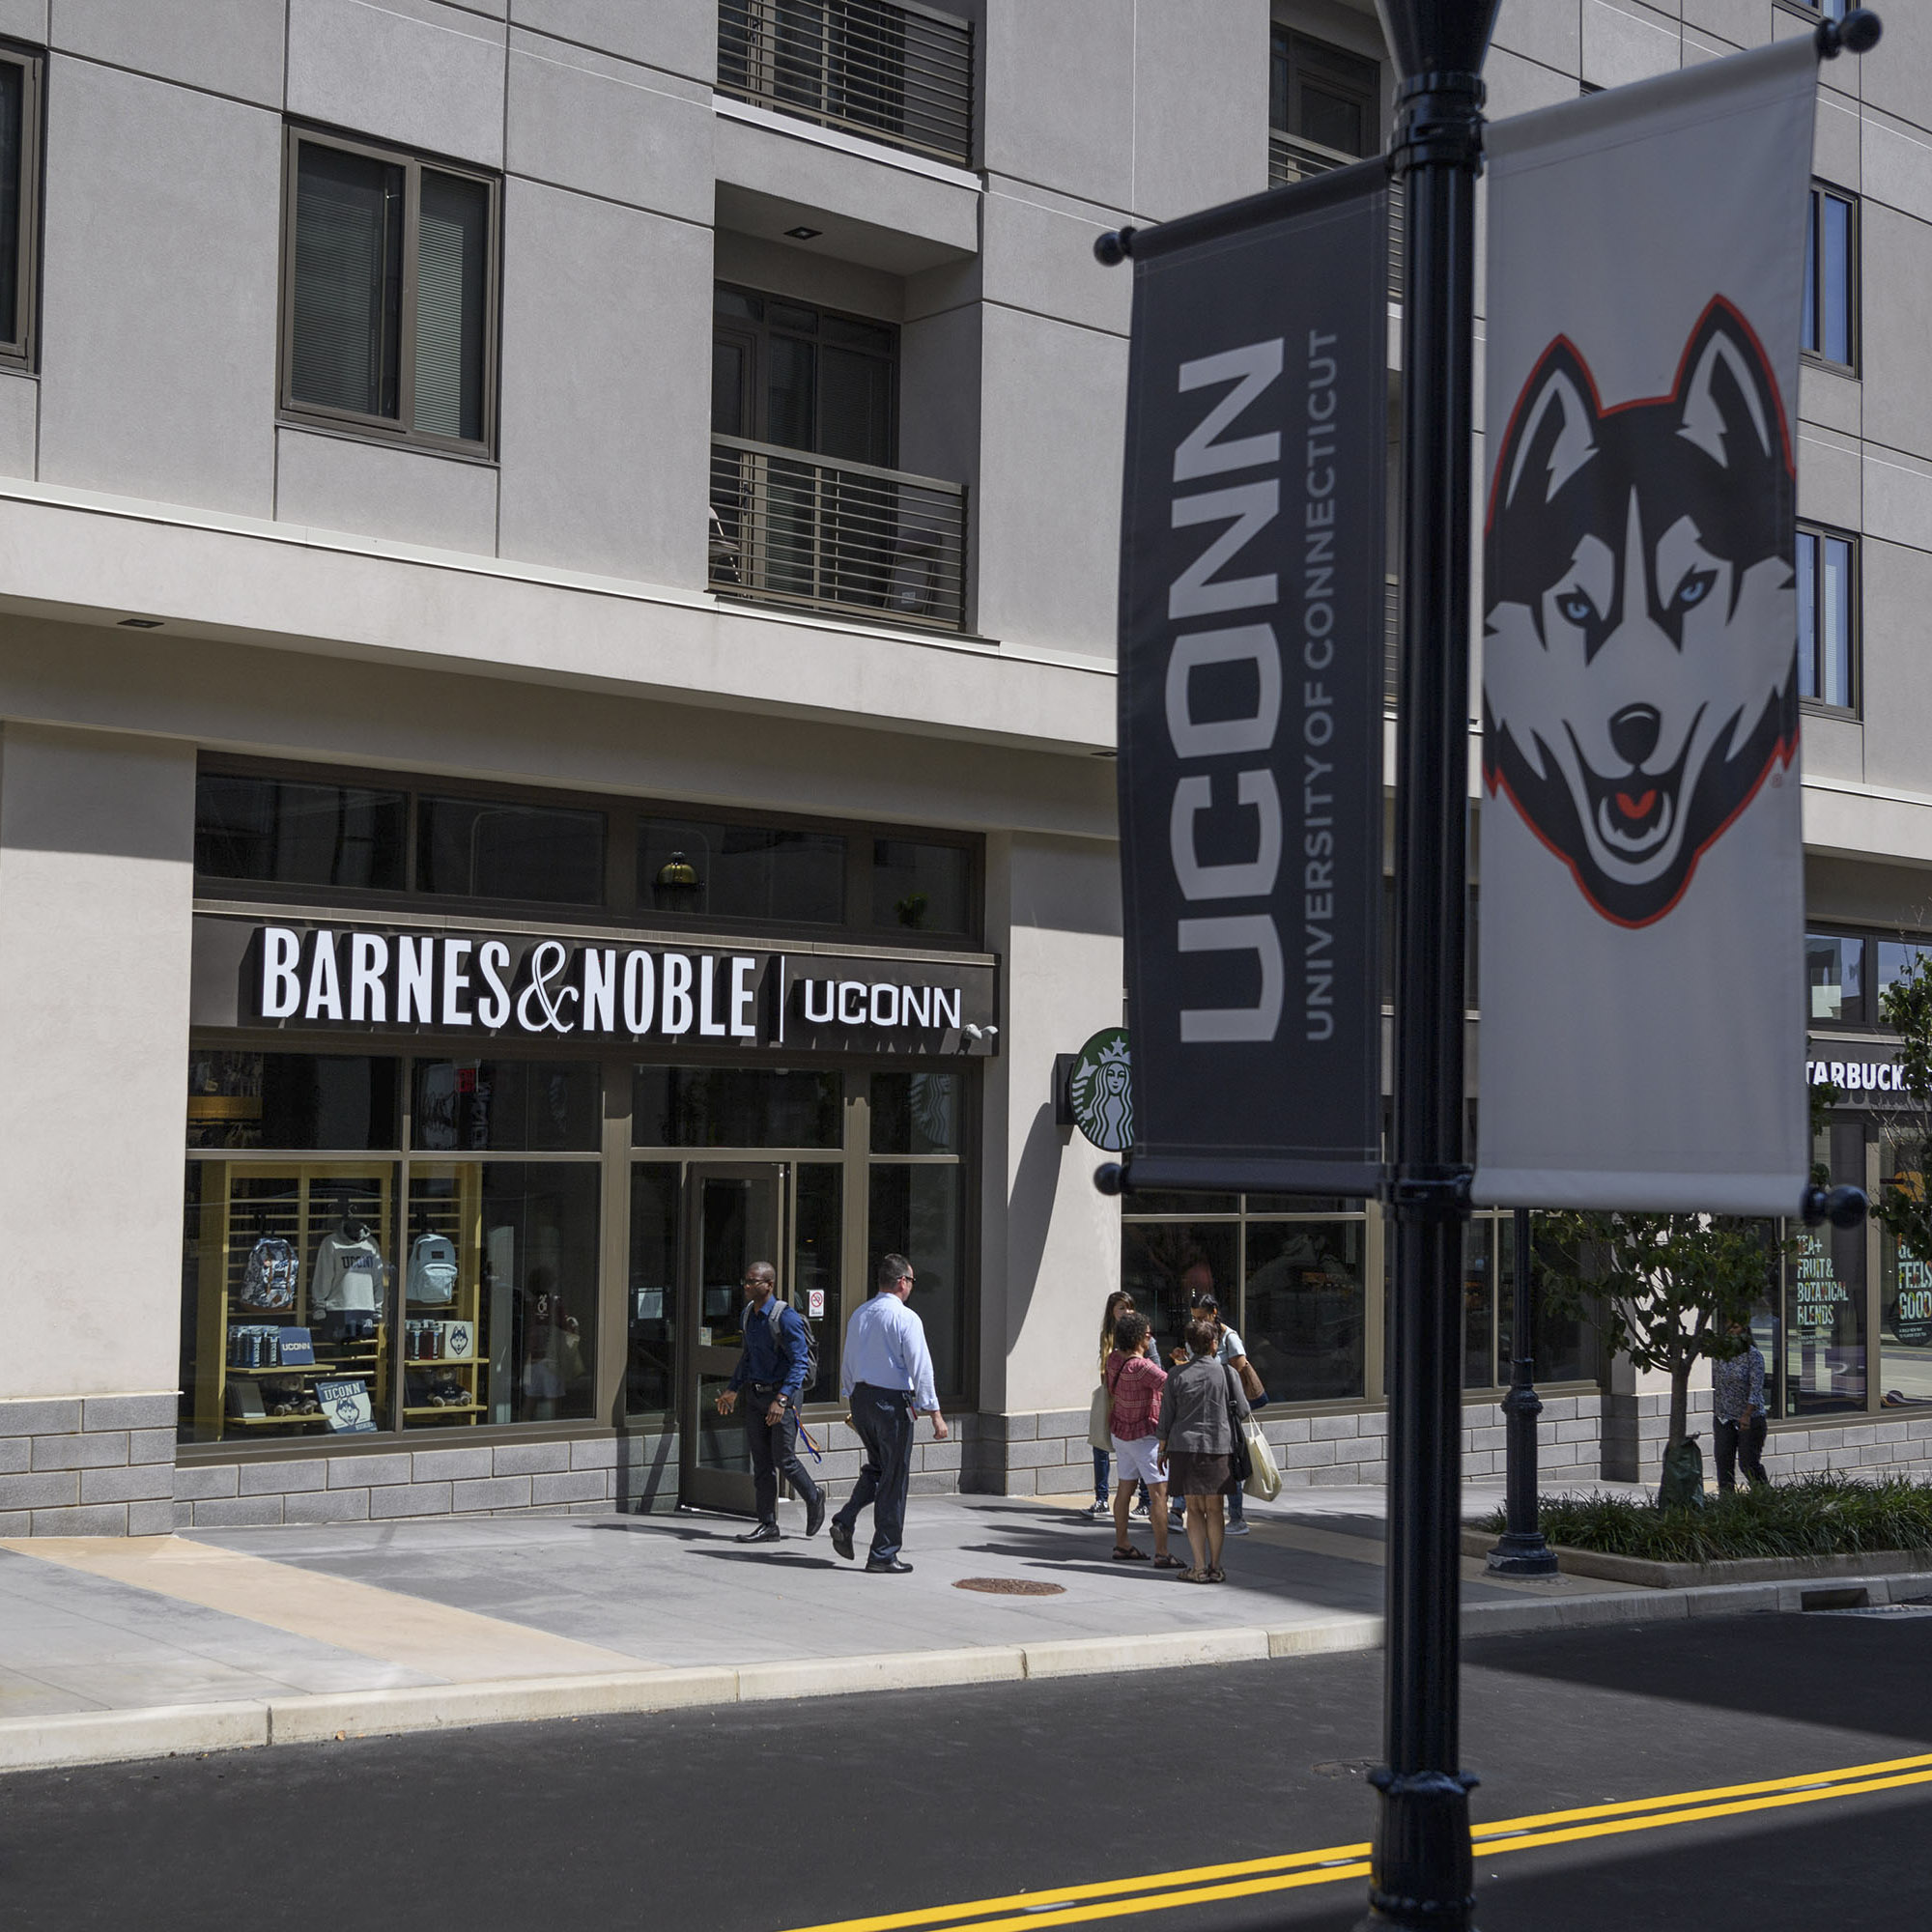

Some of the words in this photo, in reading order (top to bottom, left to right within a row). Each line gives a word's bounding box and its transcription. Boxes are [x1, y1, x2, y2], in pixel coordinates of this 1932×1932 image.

[1304, 329, 1338, 670] CONNECTICUT
[1165, 337, 1285, 1043] UCONN
[1304, 681, 1334, 747] OF
[1304, 753, 1334, 1041] UNIVERSITY
[805, 979, 962, 1029] UCONN
[1804, 1061, 1913, 1091] TARBUCK
[1898, 1261, 1932, 1289] FEELS
[1797, 1281, 1849, 1302] BOTANICAL
[1798, 1305, 1834, 1325] BLENDS
[1899, 1292, 1932, 1321] GOOD
[281, 1343, 310, 1351] UCONN
[324, 1382, 361, 1401] UCONN
